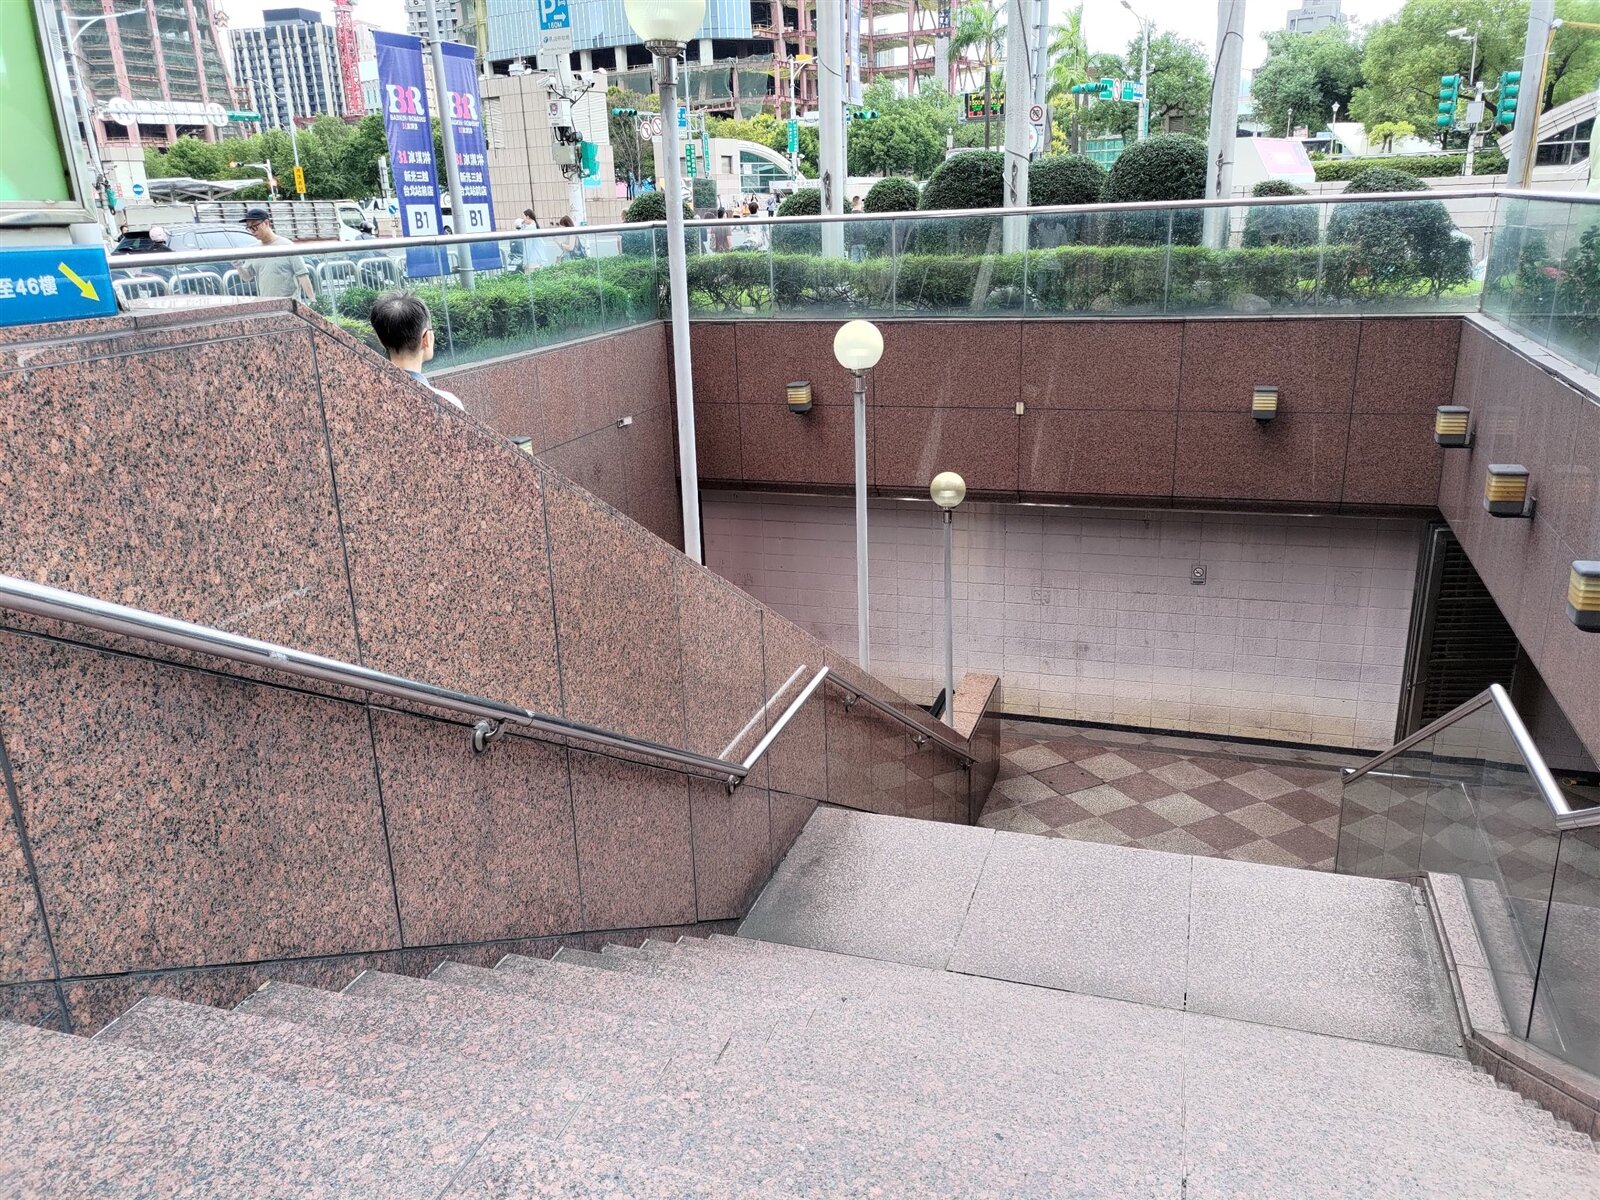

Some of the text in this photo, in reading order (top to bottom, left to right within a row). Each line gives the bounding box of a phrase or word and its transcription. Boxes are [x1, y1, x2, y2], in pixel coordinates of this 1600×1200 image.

[541, 0, 556, 23] P
[386, 84, 425, 115] BR
[404, 170, 429, 183] 新光三越
[414, 211, 429, 229] B1
[469, 209, 483, 227] B1
